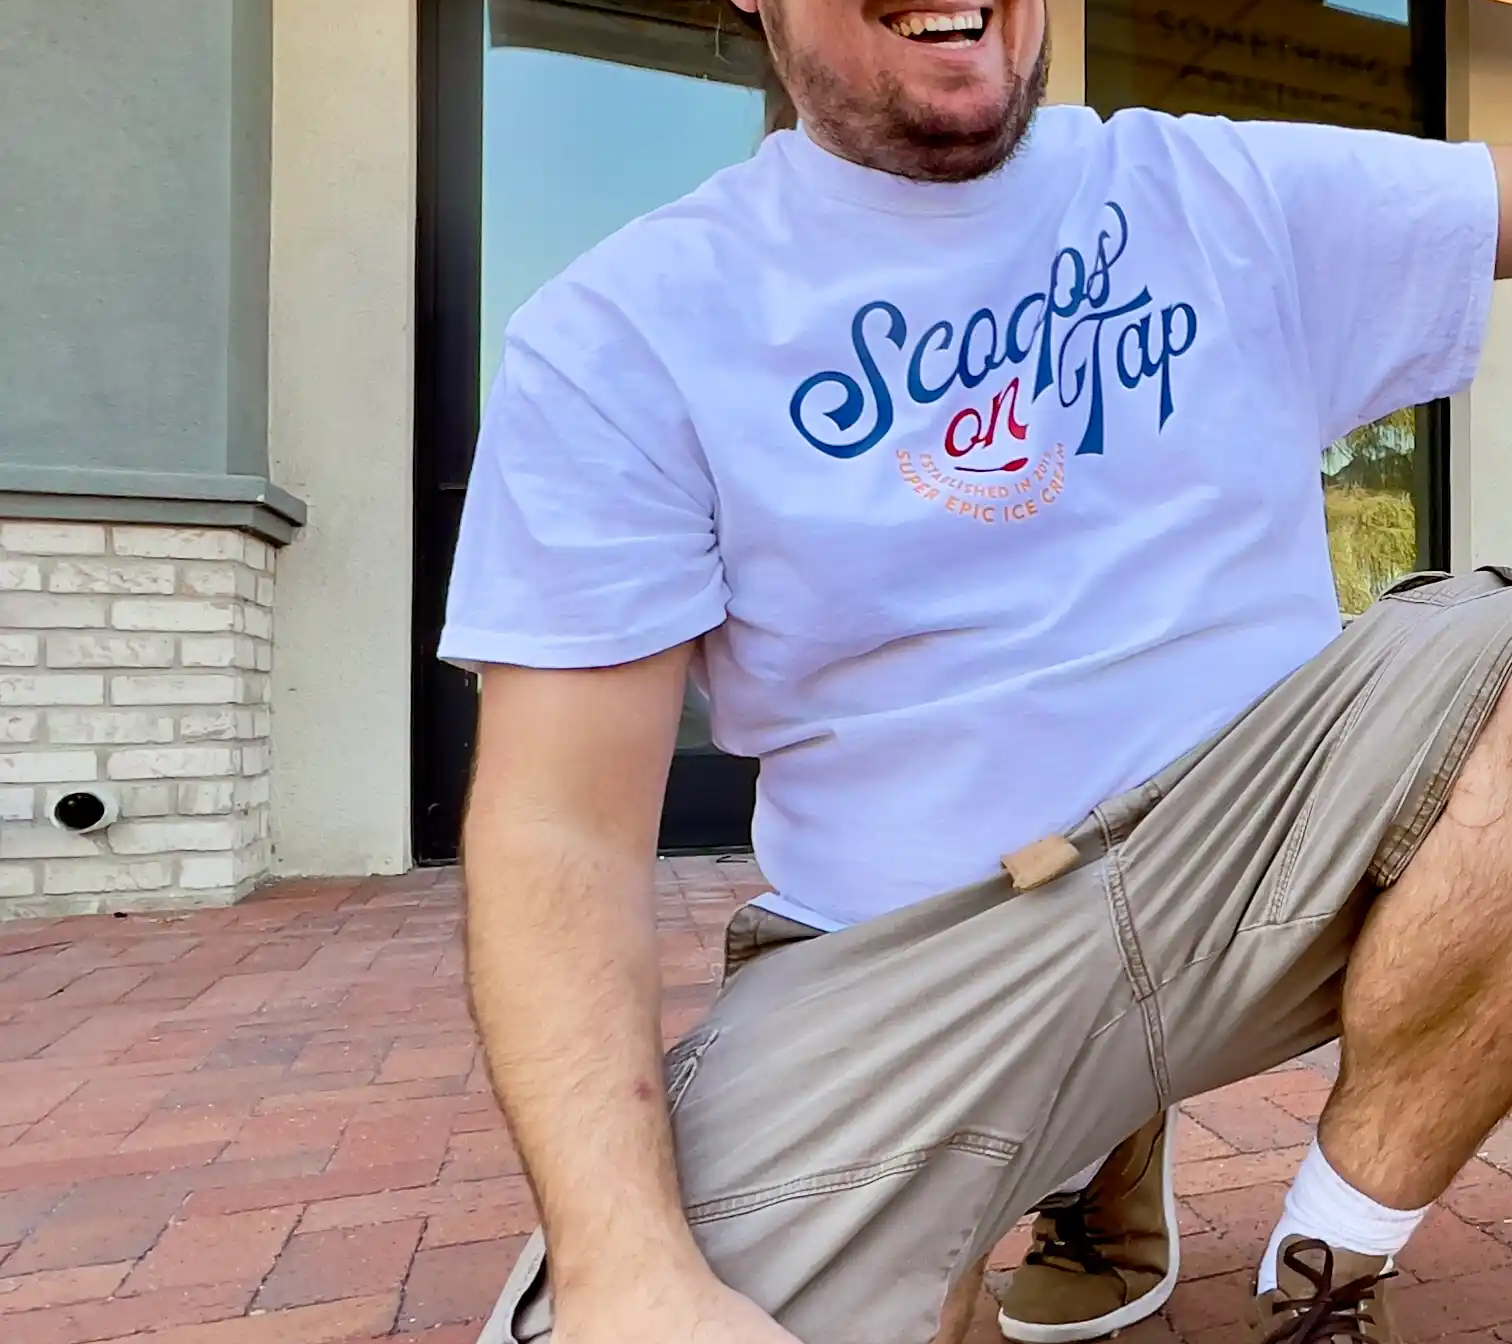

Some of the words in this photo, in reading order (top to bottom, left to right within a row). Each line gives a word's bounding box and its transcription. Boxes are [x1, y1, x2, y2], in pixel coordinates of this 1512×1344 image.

[789, 201, 1128, 459] Scoops
[944, 377, 1029, 457] on
[1058, 285, 1197, 456] Tap
[896, 448, 940, 501] SUPER
[945, 495, 996, 523] EPIC
[1004, 499, 1037, 522] ICE
[1041, 442, 1065, 504] CREAM
[919, 453, 1008, 498] ESTABLISHED
[1015, 477, 1031, 494] IN
